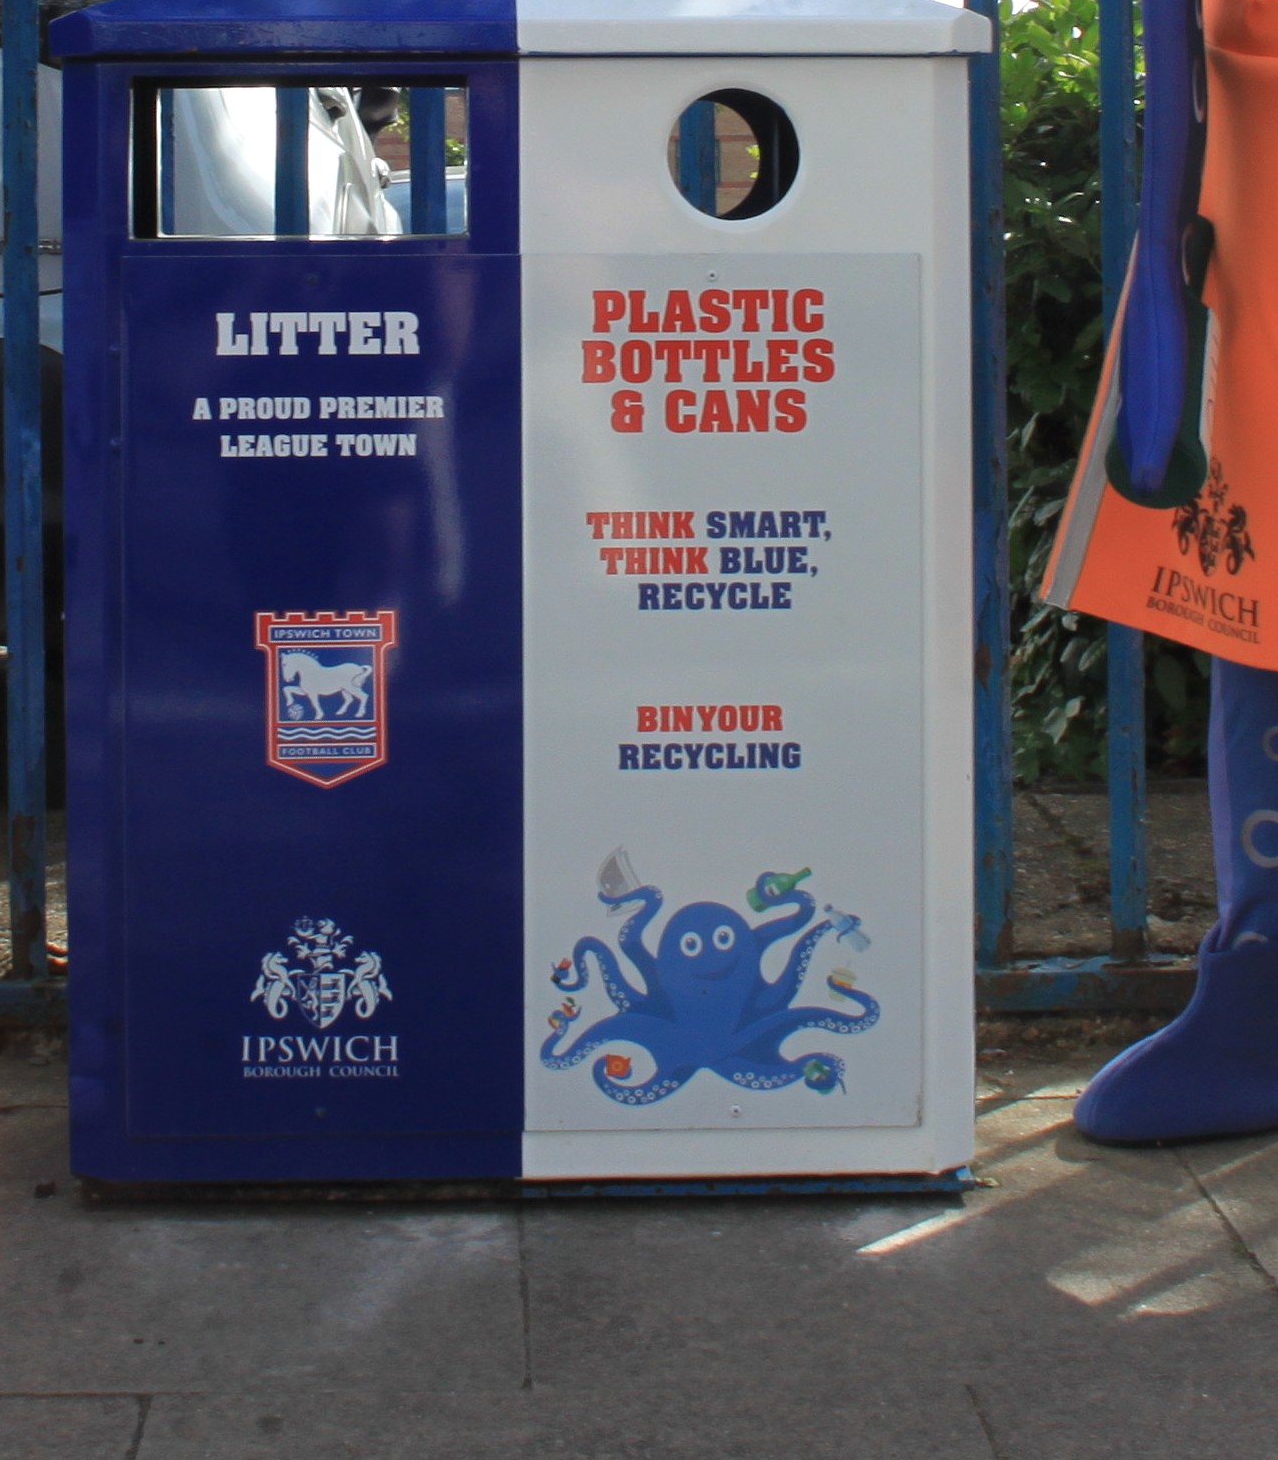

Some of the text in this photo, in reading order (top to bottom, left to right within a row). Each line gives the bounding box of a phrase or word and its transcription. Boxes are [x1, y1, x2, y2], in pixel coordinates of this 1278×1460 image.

[592, 288, 825, 333] PLASTIC
[215, 311, 420, 355] LITTER
[581, 338, 836, 384] BOTTLES
[192, 396, 445, 420] A PROUD PREMIER
[610, 389, 808, 433] & CANS
[220, 433, 418, 457] LEAGUE TOWN
[586, 511, 833, 542] THINK SMART,
[599, 546, 819, 578] THINK BLUE,
[637, 582, 793, 611] RECYCLE
[1151, 565, 1259, 628] IPSWICH
[274, 627, 377, 639] IPSWICH TOWN
[281, 746, 372, 757] FOOTBALL CLUB
[618, 742, 802, 771] RECYCLING
[241, 1035, 399, 1063] IPSWICH
[242, 1065, 400, 1078] BOROUGH COUNCIL
